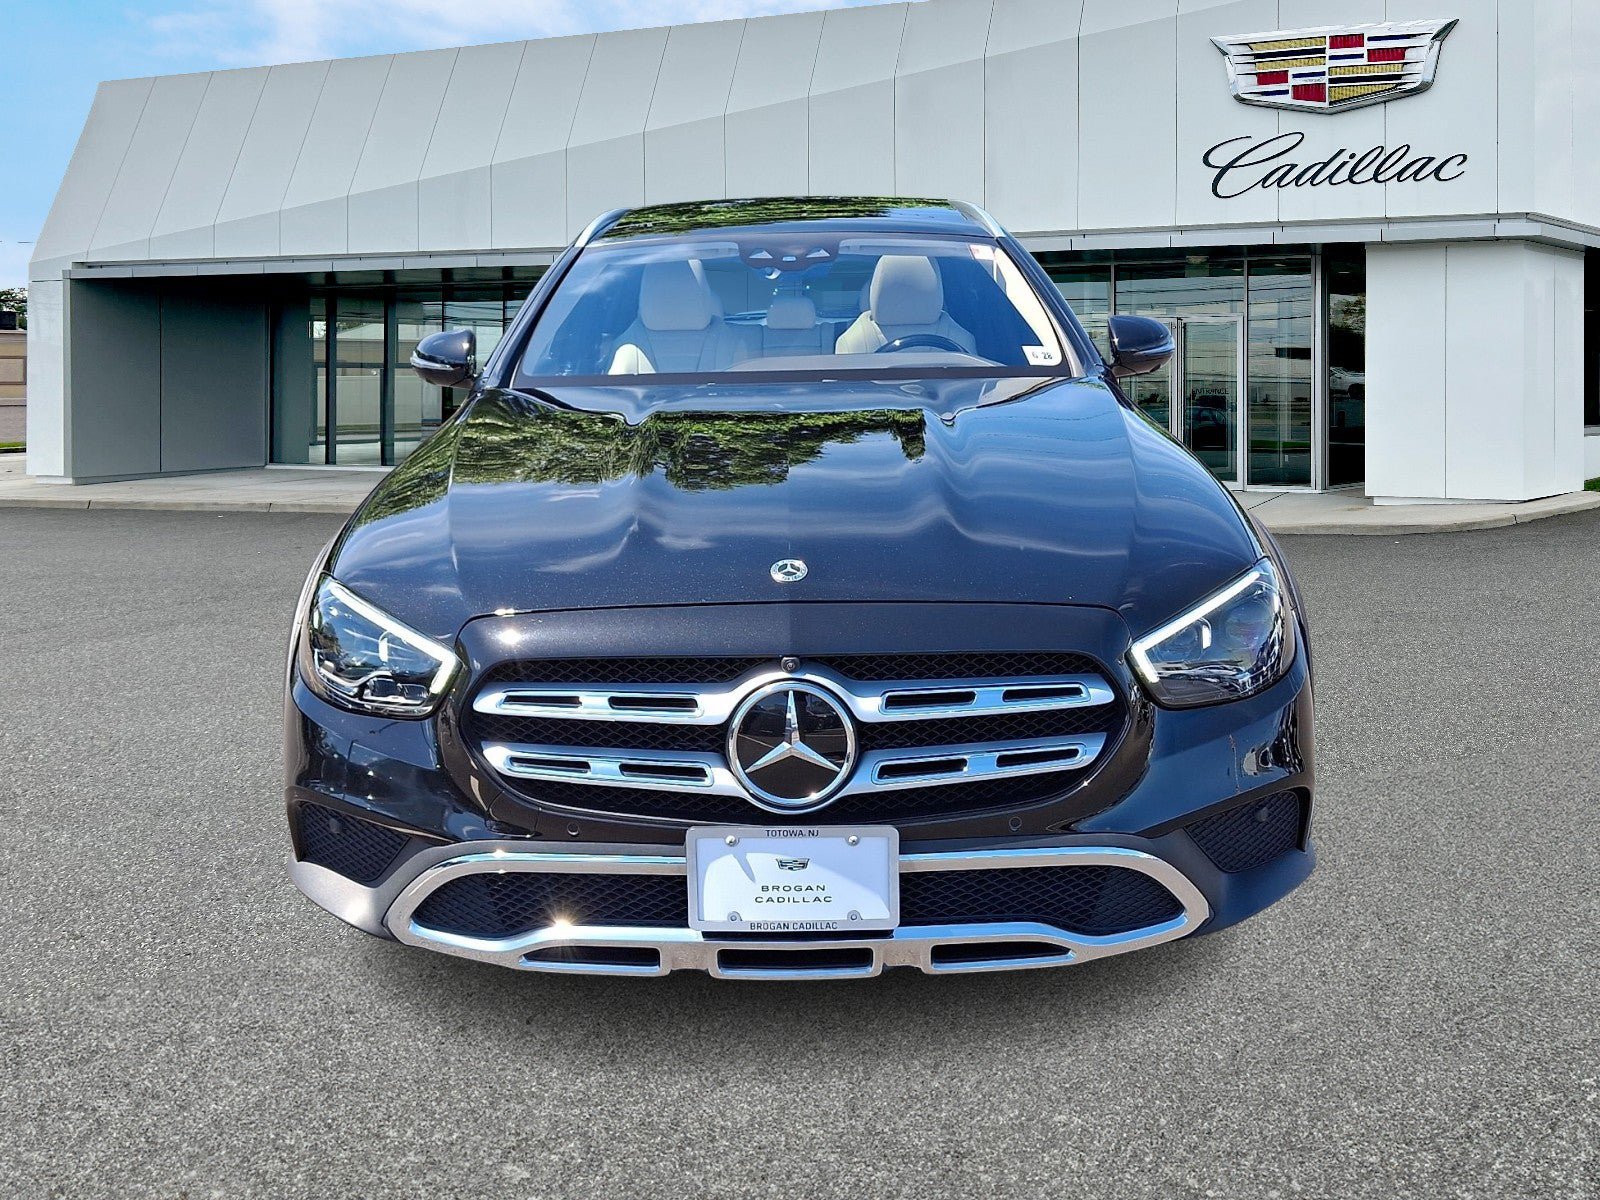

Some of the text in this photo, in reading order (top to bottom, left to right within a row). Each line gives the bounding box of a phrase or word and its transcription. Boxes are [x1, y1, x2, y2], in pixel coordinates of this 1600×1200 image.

[1203, 132, 1468, 199] Cadillac
[808, 829, 819, 838] NJ
[761, 884, 826, 892] BROGAN
[750, 921, 838, 931] BROGAN CADILLAC
